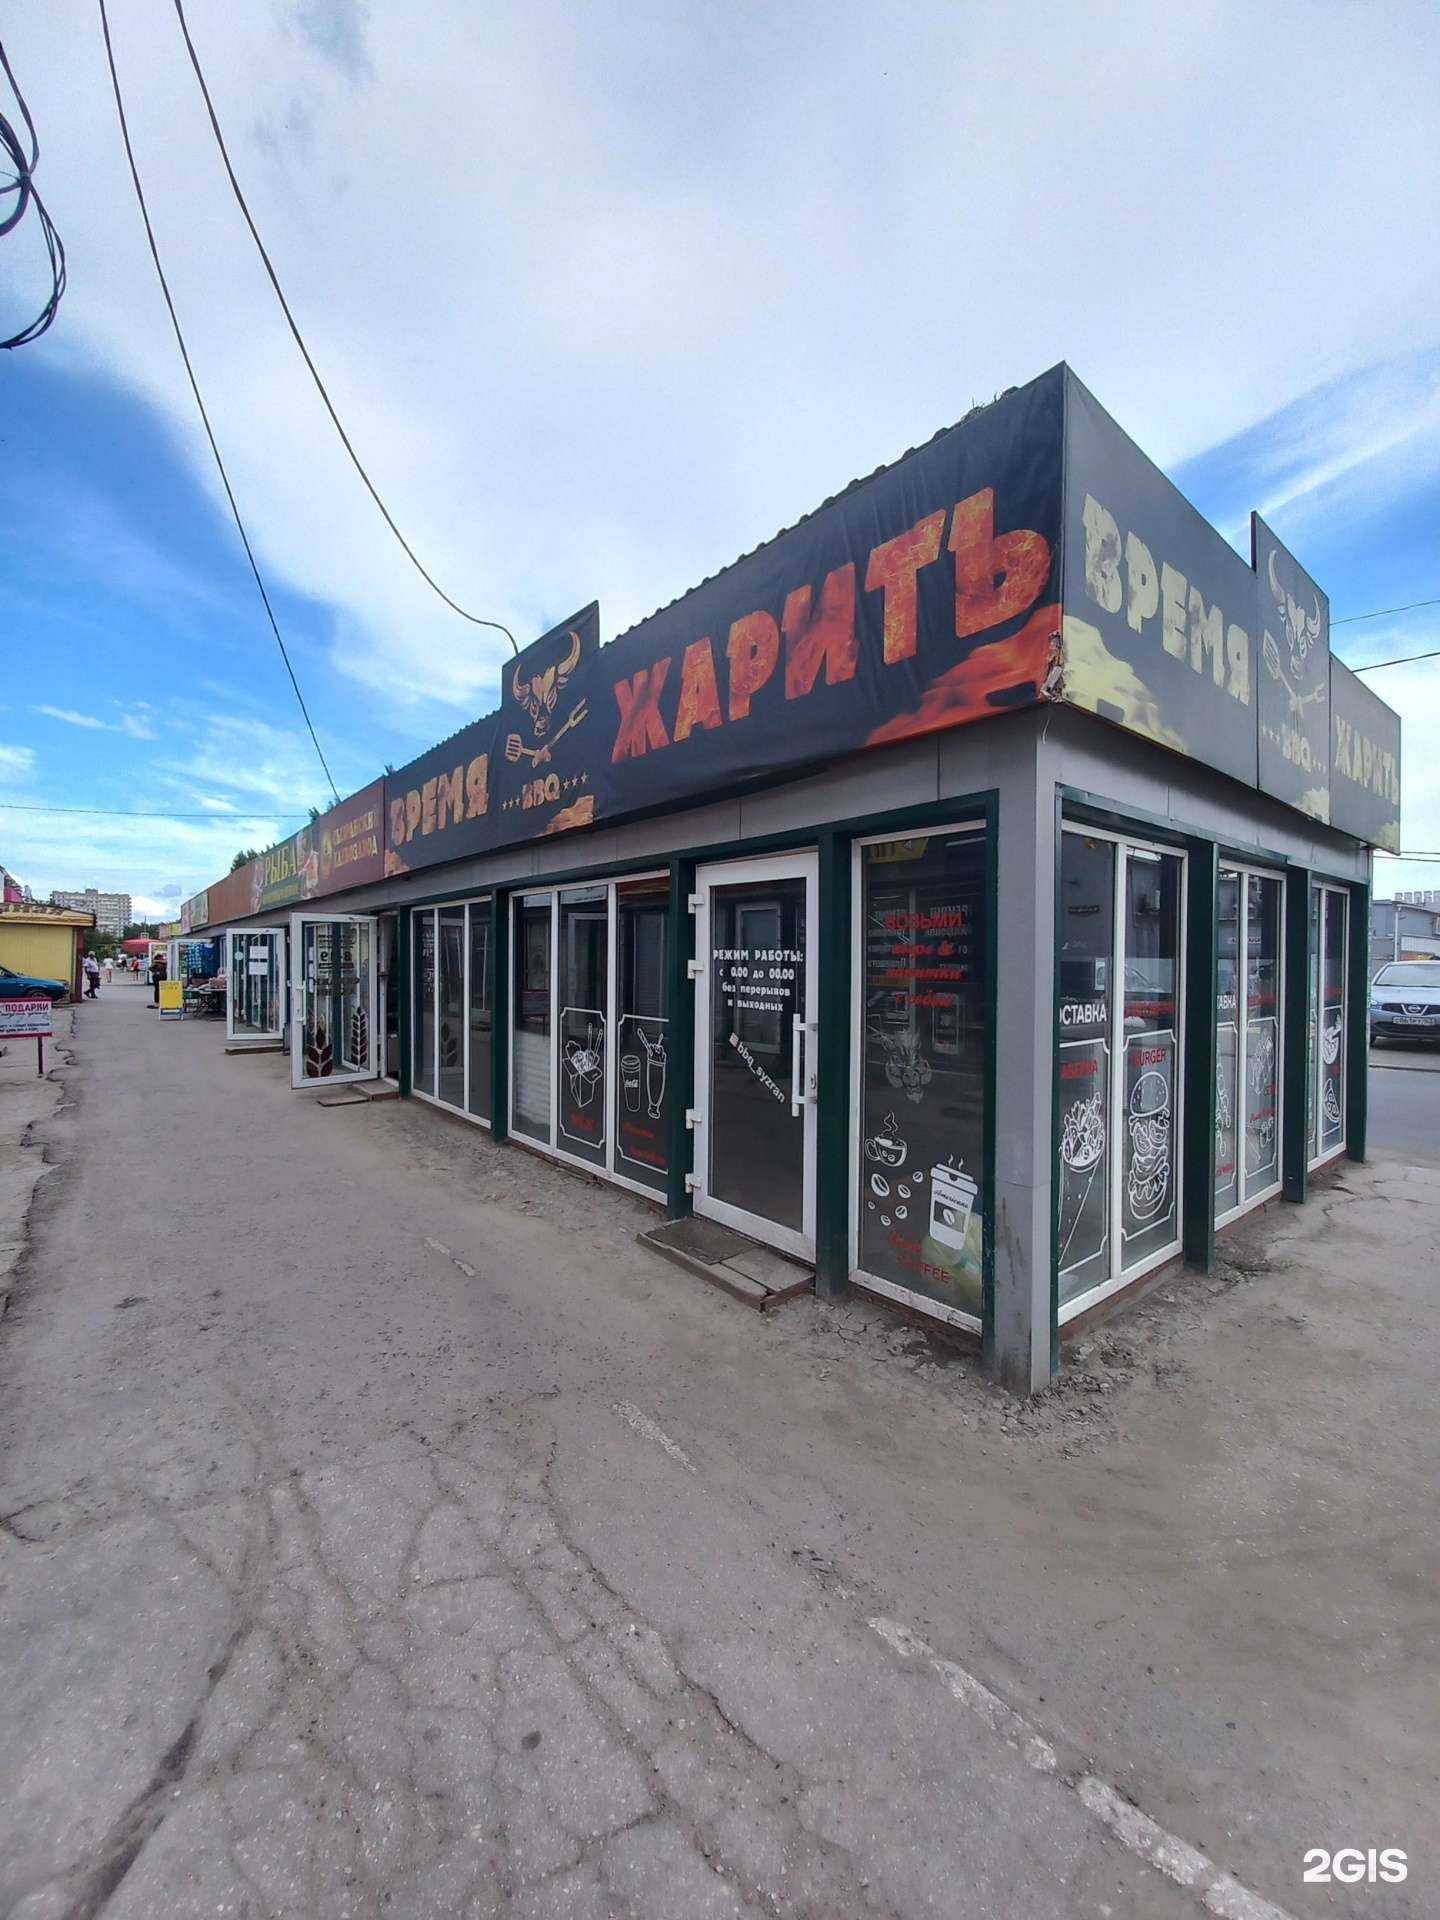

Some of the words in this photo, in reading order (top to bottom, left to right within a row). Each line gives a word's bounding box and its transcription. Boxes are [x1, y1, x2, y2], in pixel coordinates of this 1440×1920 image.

[1082, 493, 1250, 705] ВРЕМЯ
[611, 487, 1051, 763] ЖАРИТЬ
[389, 753, 489, 847] ВРЕМЯ
[522, 773, 560, 811] BBQ
[713, 949, 749, 961] РЕЖИМ
[755, 949, 804, 963] РАБОТЫ:
[753, 969, 764, 980] до
[722, 982, 736, 993] без
[741, 985, 791, 996] перерывов
[5, 1003, 49, 1013] ПОДАРКИ
[737, 1000, 784, 1012] выходных
[738, 1042, 785, 1103] bbq_syzran
